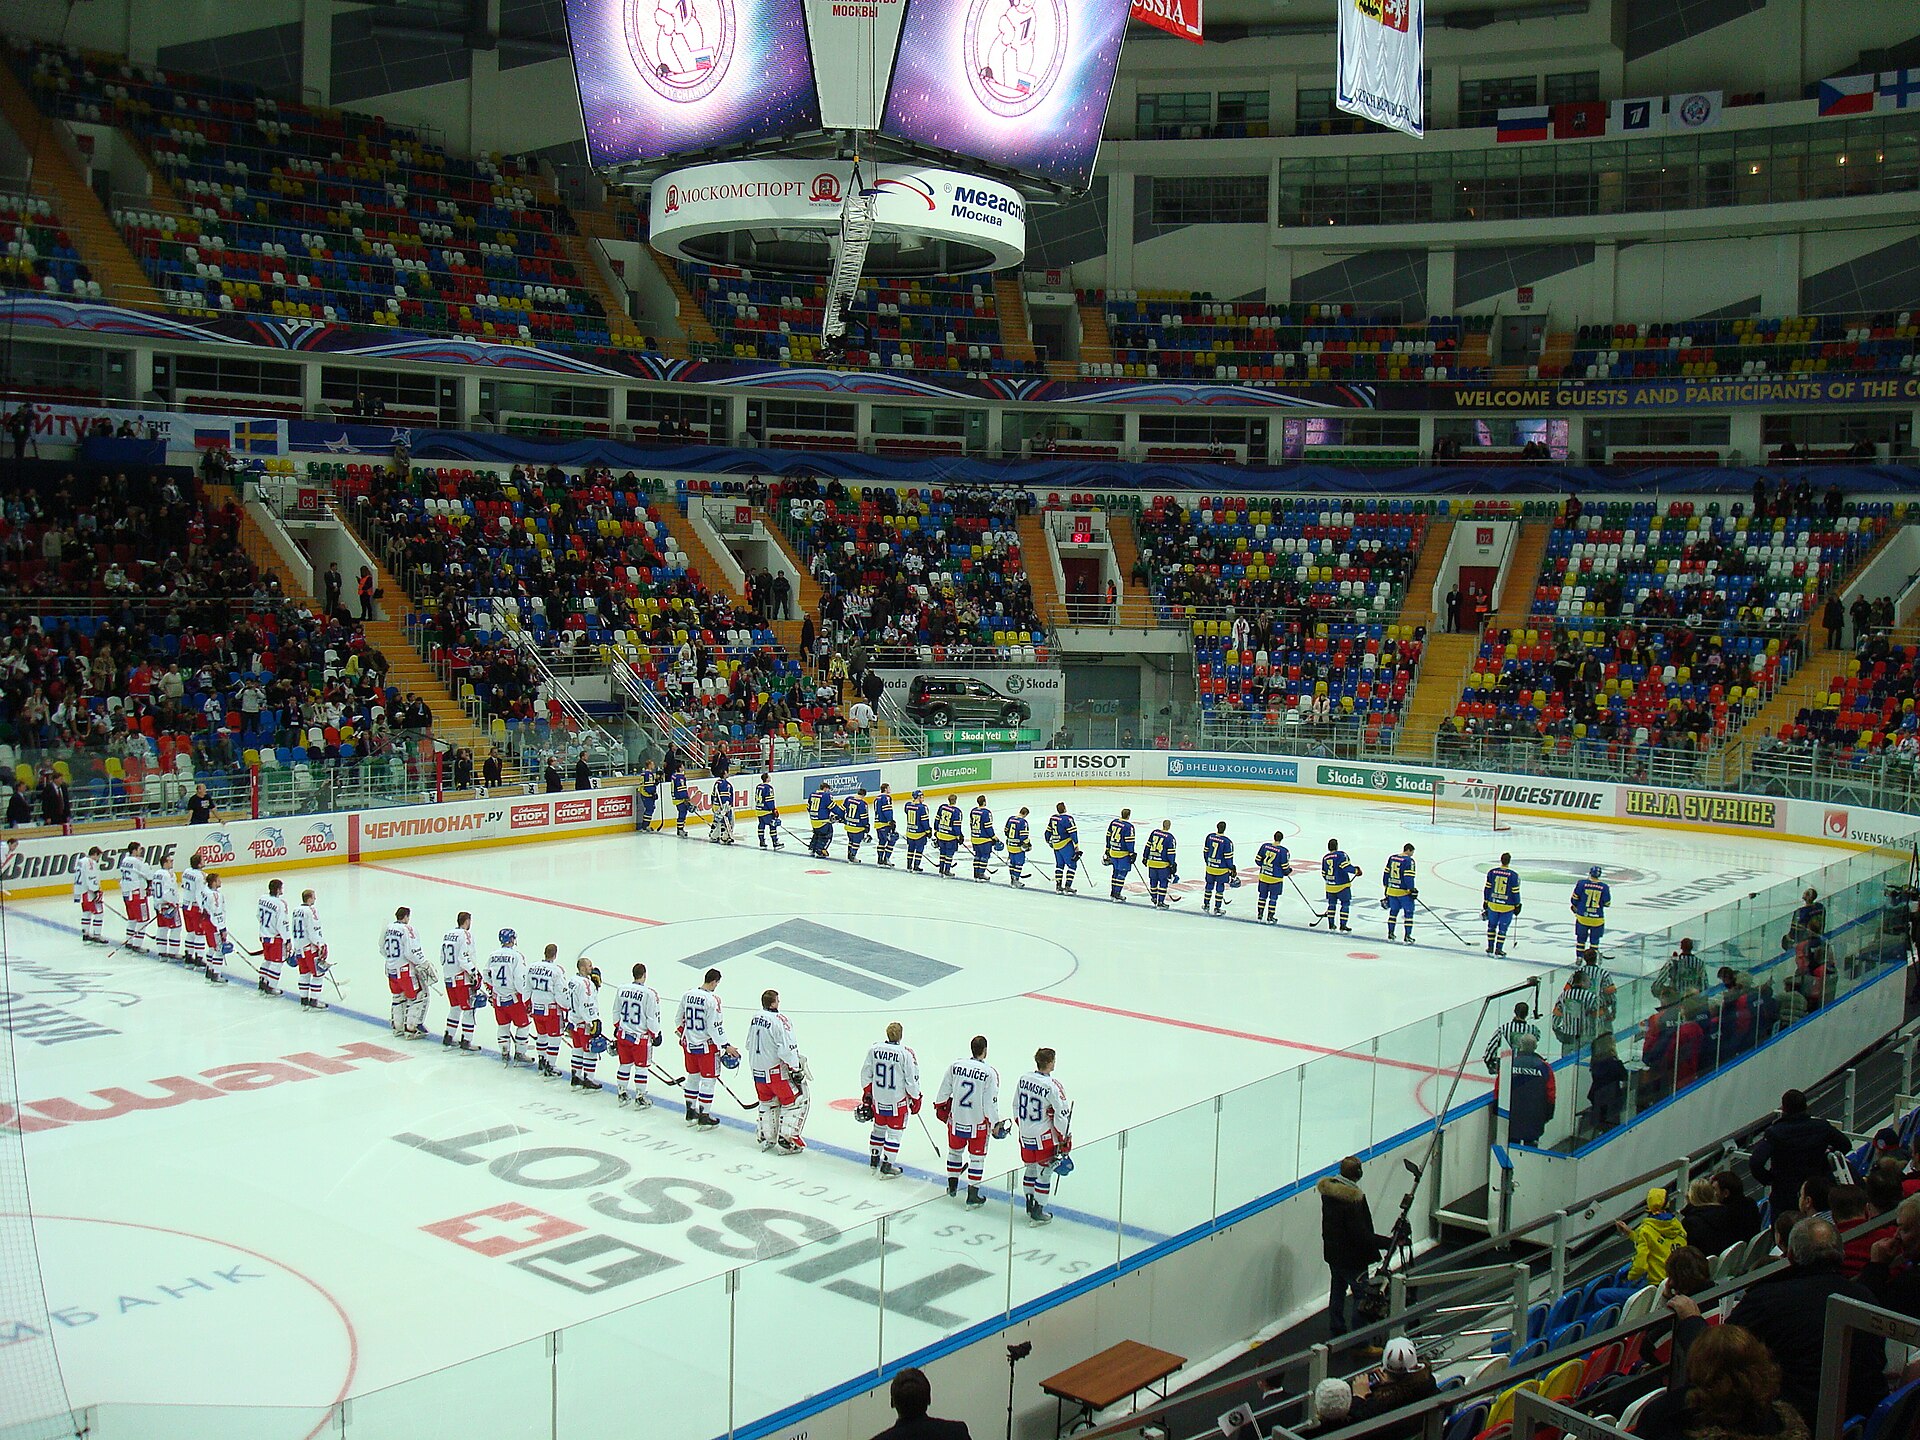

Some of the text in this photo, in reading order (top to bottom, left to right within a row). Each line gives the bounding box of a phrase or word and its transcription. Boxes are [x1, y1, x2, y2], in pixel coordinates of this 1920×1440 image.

[681, 181, 806, 204] МОСКОМСПОРТ
[951, 204, 1003, 227] Москва
[1455, 390, 1550, 407] WELCOME
[1556, 389, 1629, 406] GUESTS
[1634, 388, 1679, 404] AND
[1685, 383, 1822, 403] PARTICIPANTS
[1828, 382, 1856, 399] OF
[1861, 380, 1898, 398] THE
[301, 496, 314, 508] C3
[1078, 522, 1088, 532] D1
[881, 677, 907, 689] koda
[1026, 674, 1059, 689] Škoda
[961, 731, 1001, 741] Škoda Yeti
[1059, 755, 1130, 769] TISSOT
[1186, 763, 1295, 777] ВНЕШЭКОНОМБАНК
[1327, 768, 1433, 792] Škoda Škoda
[556, 807, 591, 817] СПОРТ
[598, 803, 631, 813] СПОРТ
[1626, 790, 1775, 828] HEJA SVERIGE
[512, 811, 548, 822] СПОРТ
[247, 839, 273, 851] АВТО
[298, 834, 324, 846] АВТО
[1851, 830, 1896, 846] SVENSKA
[196, 844, 221, 855] АВТО
[255, 847, 287, 859] РАДИО
[306, 841, 337, 853] РАДИО
[202, 852, 235, 864] РАДИО
[1494, 875, 1508, 895] 16
[496, 965, 507, 987] 4
[620, 1001, 642, 1026] 43
[686, 1007, 706, 1031] 95
[755, 1029, 761, 1054] 1
[873, 1049, 900, 1063] KVAPIL
[875, 1064, 896, 1091] 91
[1512, 1067, 1543, 1077] RUSSIA
[959, 1081, 975, 1108] 2
[1018, 1093, 1042, 1122] 83
[392, 1124, 995, 1329] TISSOT
